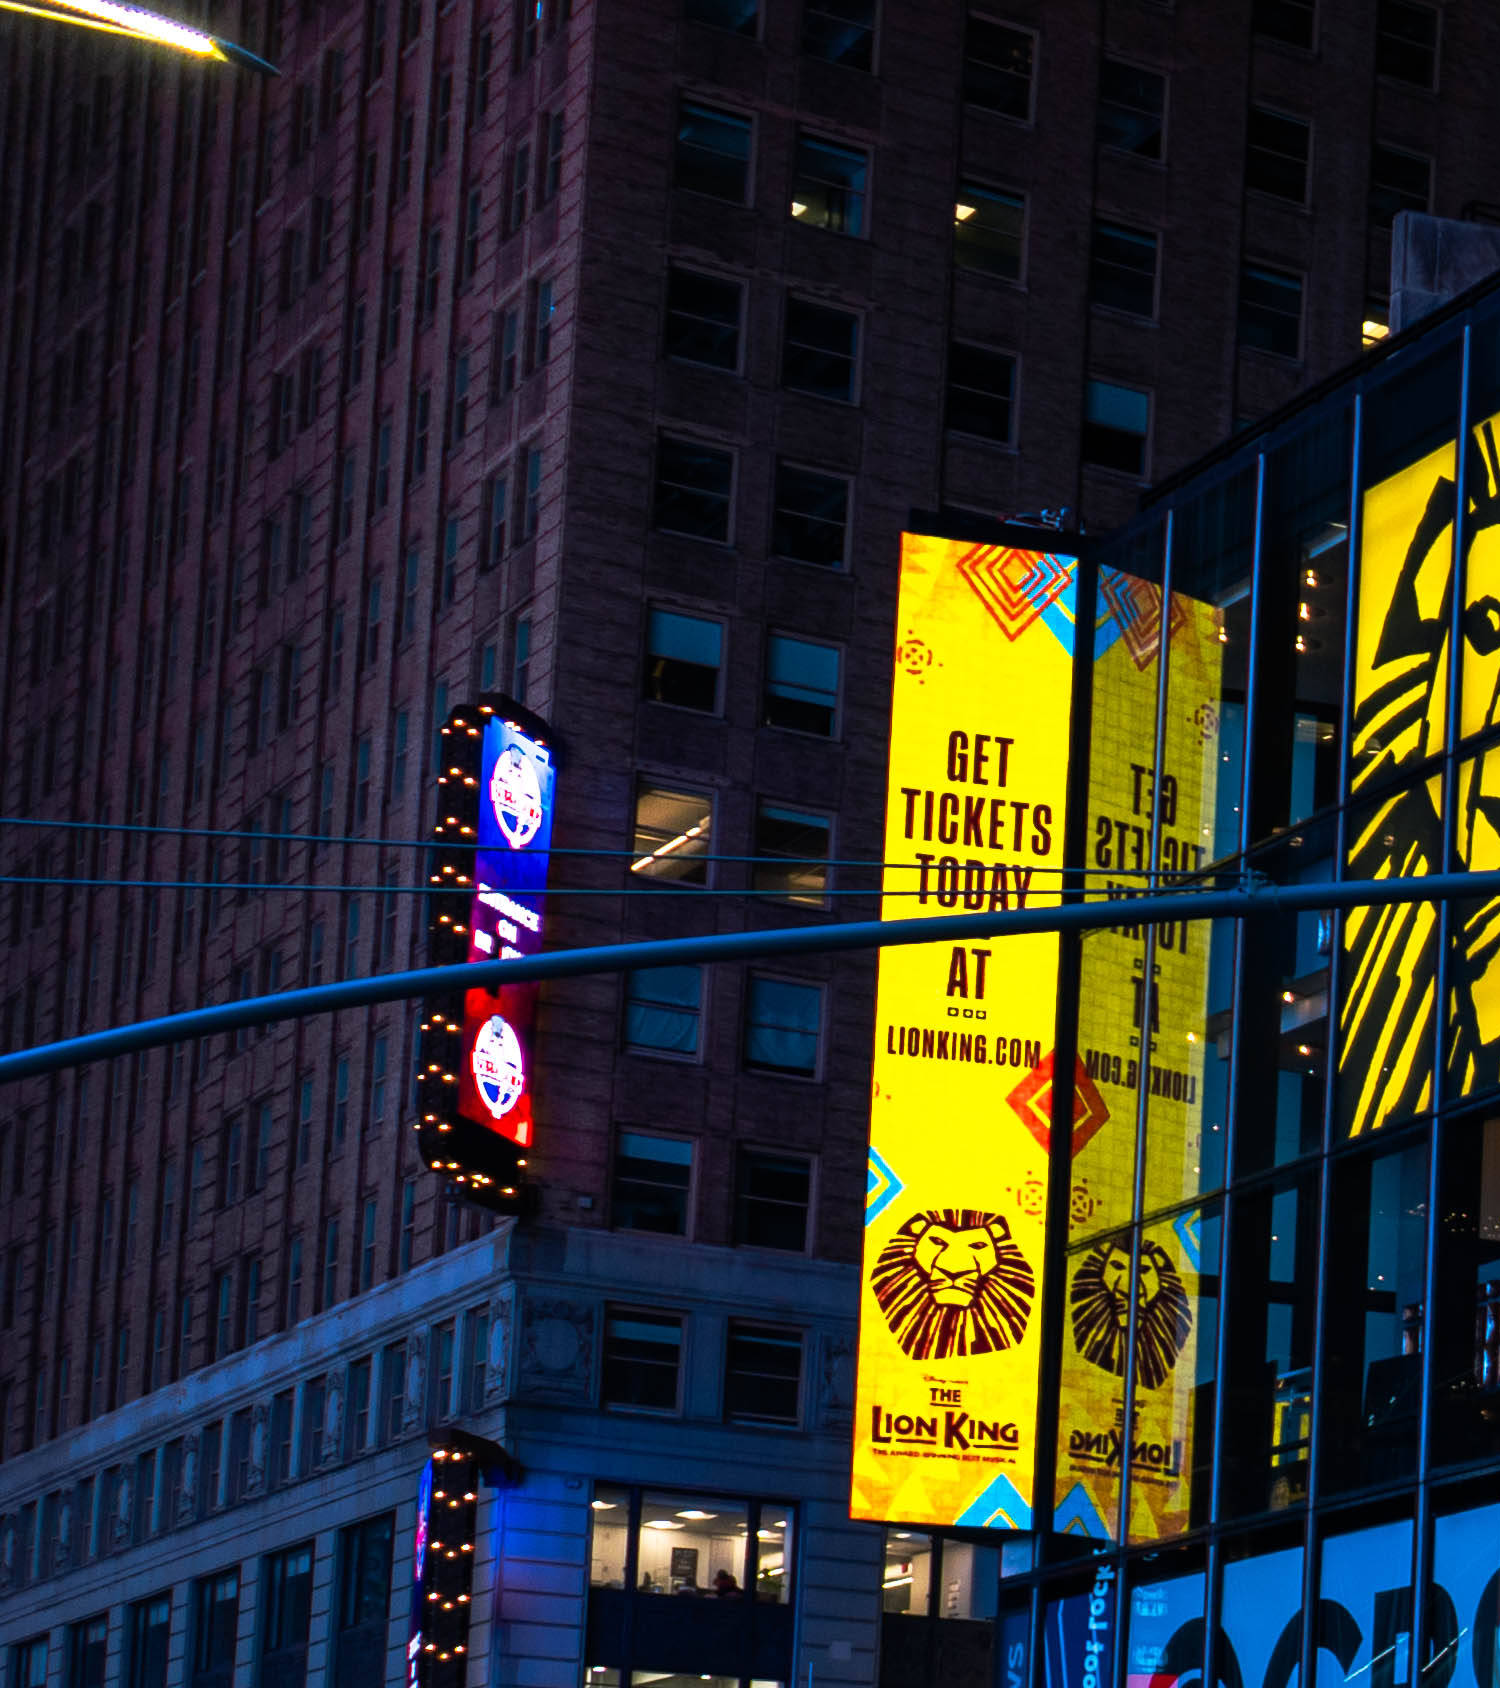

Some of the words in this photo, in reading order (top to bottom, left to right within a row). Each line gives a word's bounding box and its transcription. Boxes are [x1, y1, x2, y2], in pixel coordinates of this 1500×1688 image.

[947, 730, 1014, 788] GET
[901, 787, 1052, 856] TICKETS
[915, 853, 1034, 916] TODAY
[946, 946, 992, 1000] AT
[887, 1025, 1041, 1069] LIONKING.COM
[929, 1387, 961, 1402] THE
[872, 1405, 937, 1443] LION
[944, 1411, 1018, 1450] KING
